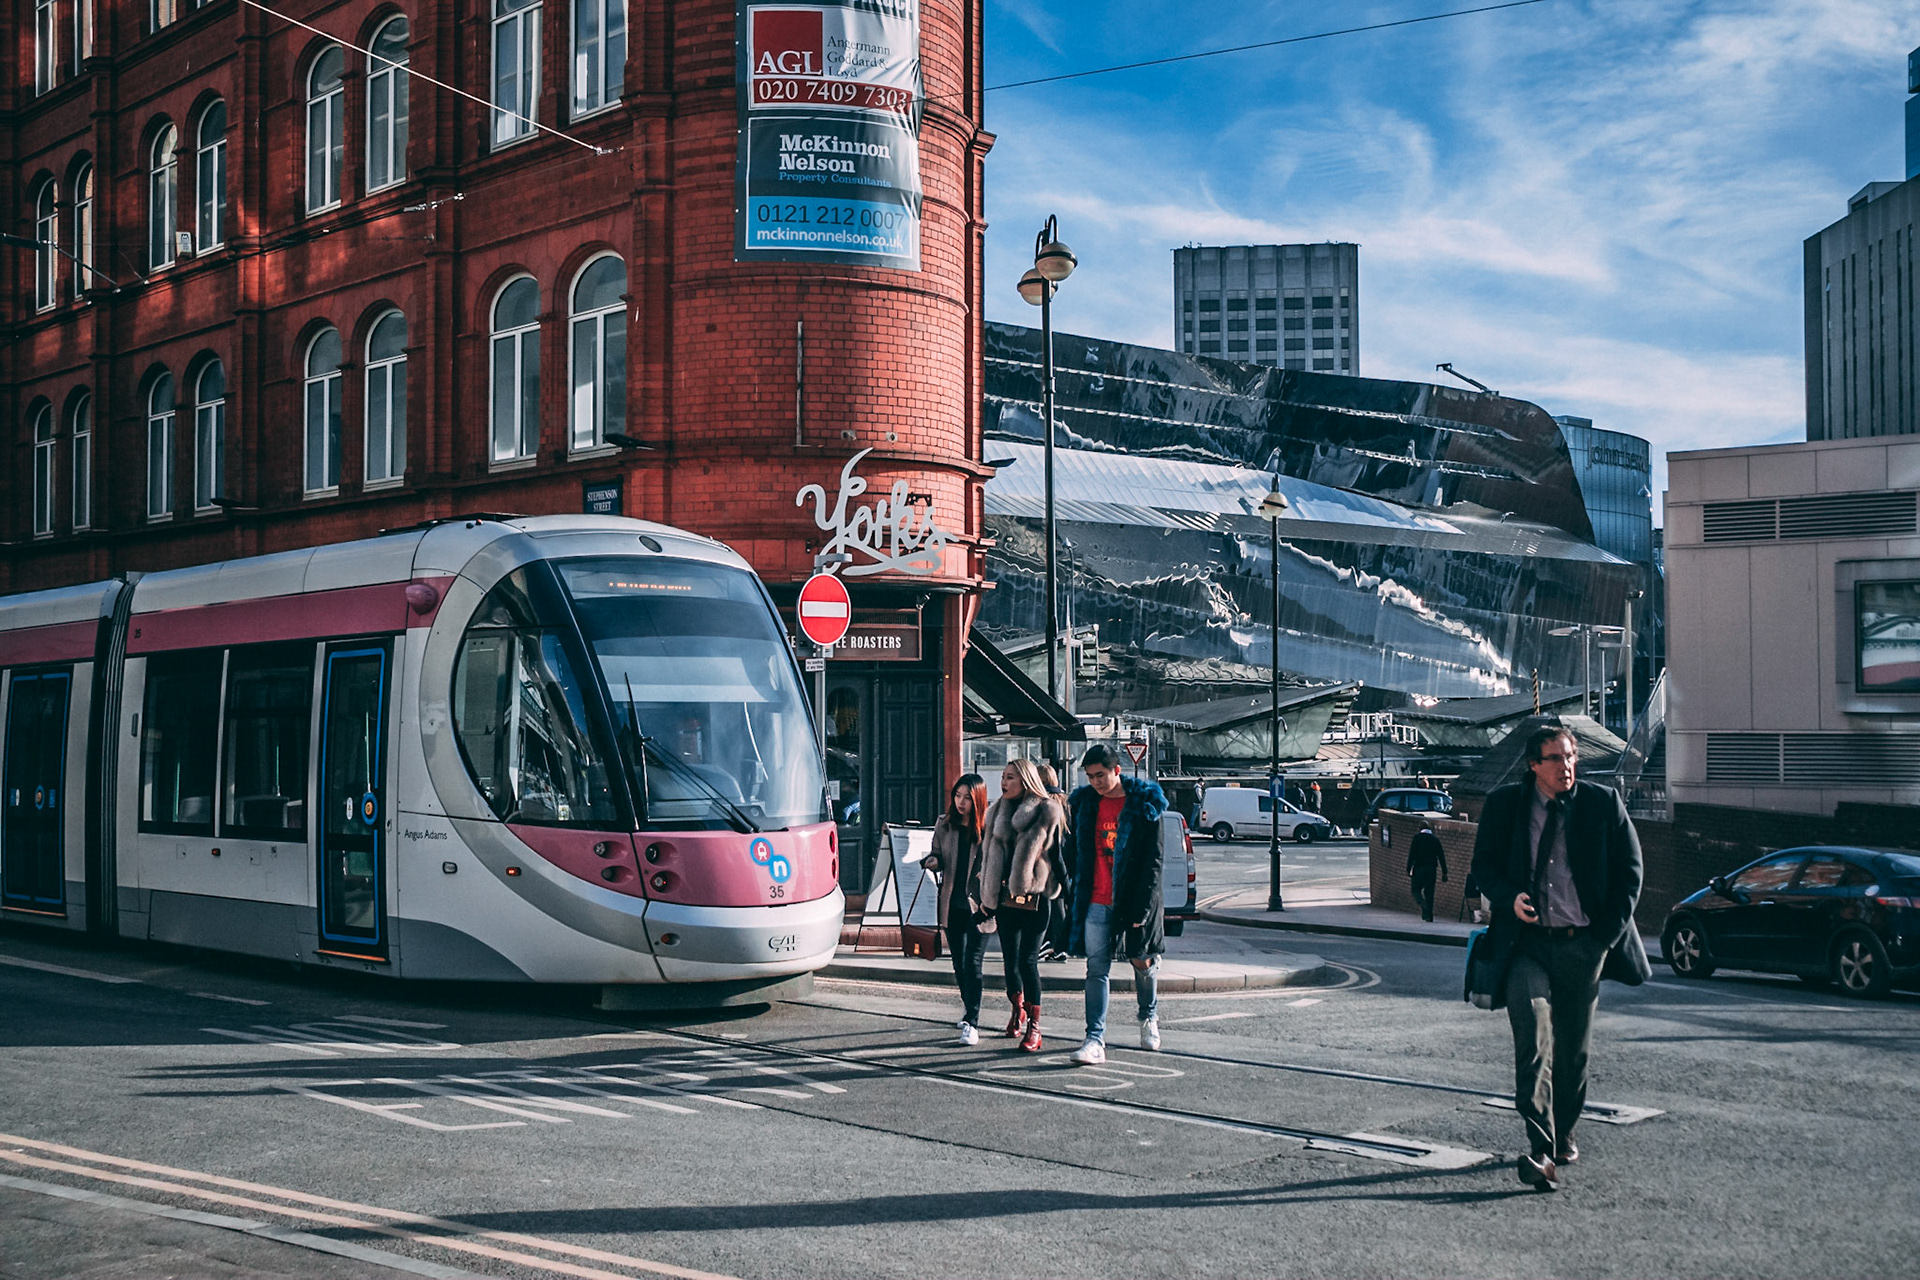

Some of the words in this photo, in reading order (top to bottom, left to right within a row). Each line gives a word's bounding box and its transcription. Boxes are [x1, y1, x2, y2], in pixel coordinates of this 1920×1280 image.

[827, 36, 891, 56] Angermann
[755, 50, 822, 75] AGL
[827, 52, 878, 68] Goddard
[758, 80, 798, 100] 020
[806, 81, 857, 102] 7409
[864, 86, 907, 110] 7303
[779, 134, 891, 159] McKinnon
[779, 153, 856, 173] Nelson
[779, 172, 828, 184] Property
[831, 173, 892, 188] Consultants
[757, 204, 810, 223] 0121
[817, 206, 855, 225] 212
[860, 208, 904, 230] 0007
[757, 227, 903, 249] mckinnonnelson.co.uk
[1585, 438, 1620, 470] John
[587, 489, 618, 501] STEPHENSON
[593, 501, 611, 512] STREET
[796, 447, 960, 576] Yorks
[850, 636, 902, 649] ROASTERS
[404, 829, 423, 841] Angus
[424, 829, 448, 840] Adams
[769, 885, 785, 899] 35
